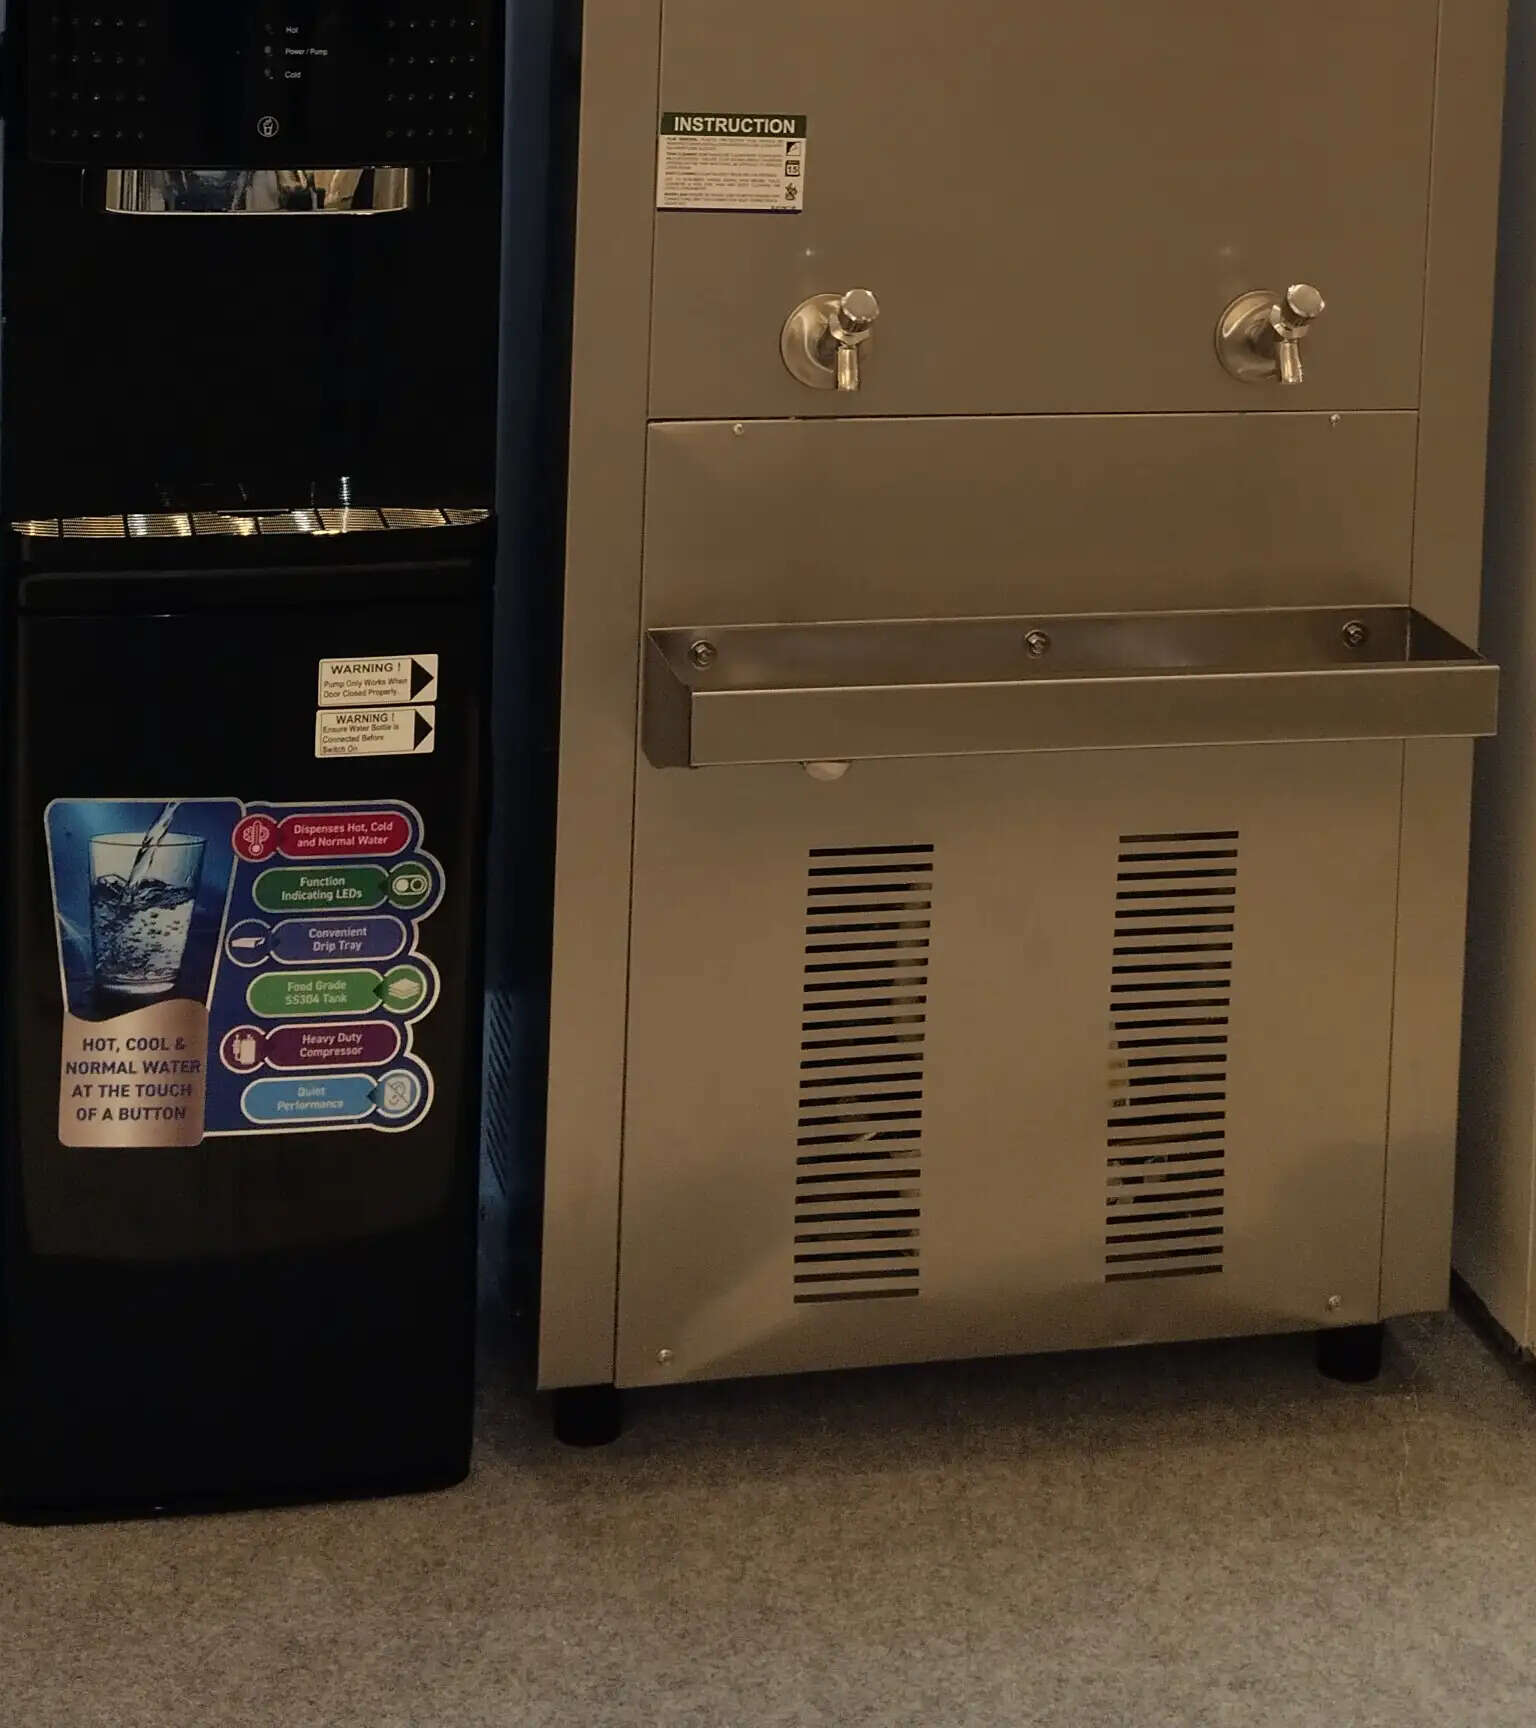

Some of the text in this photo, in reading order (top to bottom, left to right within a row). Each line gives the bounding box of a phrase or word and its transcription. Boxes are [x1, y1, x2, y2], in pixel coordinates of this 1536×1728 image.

[286, 26, 298, 34] Hot
[285, 48, 304, 56] Power
[284, 71, 301, 79] Cold
[674, 116, 796, 134] INSTRUCTION
[331, 663, 393, 674] WARNING
[324, 680, 344, 689] Pump
[346, 679, 362, 688] Only
[364, 678, 386, 686] Works
[323, 690, 340, 698] Door
[343, 689, 367, 697] Closed
[336, 713, 388, 724] WARNING
[349, 724, 369, 732] Water
[323, 734, 384, 744] Connected Before
[294, 822, 393, 835] Dispenses Hot, Cold
[297, 835, 388, 847] and Normal Water
[300, 876, 345, 887] Function
[281, 888, 363, 902] Indicating LEDs
[308, 928, 367, 939] Convenient
[313, 940, 362, 953] Drip Tray
[287, 980, 347, 992] Food Grade
[285, 994, 347, 1006] SS304 Tank
[82, 1037, 186, 1053] HOT, COOL &
[302, 1032, 362, 1046] Heavy Duty
[299, 1046, 363, 1059] Compressor
[66, 1059, 201, 1075] NORMAL WATER
[71, 1083, 192, 1098] AT THE TOUCH
[298, 1087, 325, 1097] Quiet
[277, 1100, 344, 1112] Performance
[76, 1106, 187, 1121] OF A BUTTON
